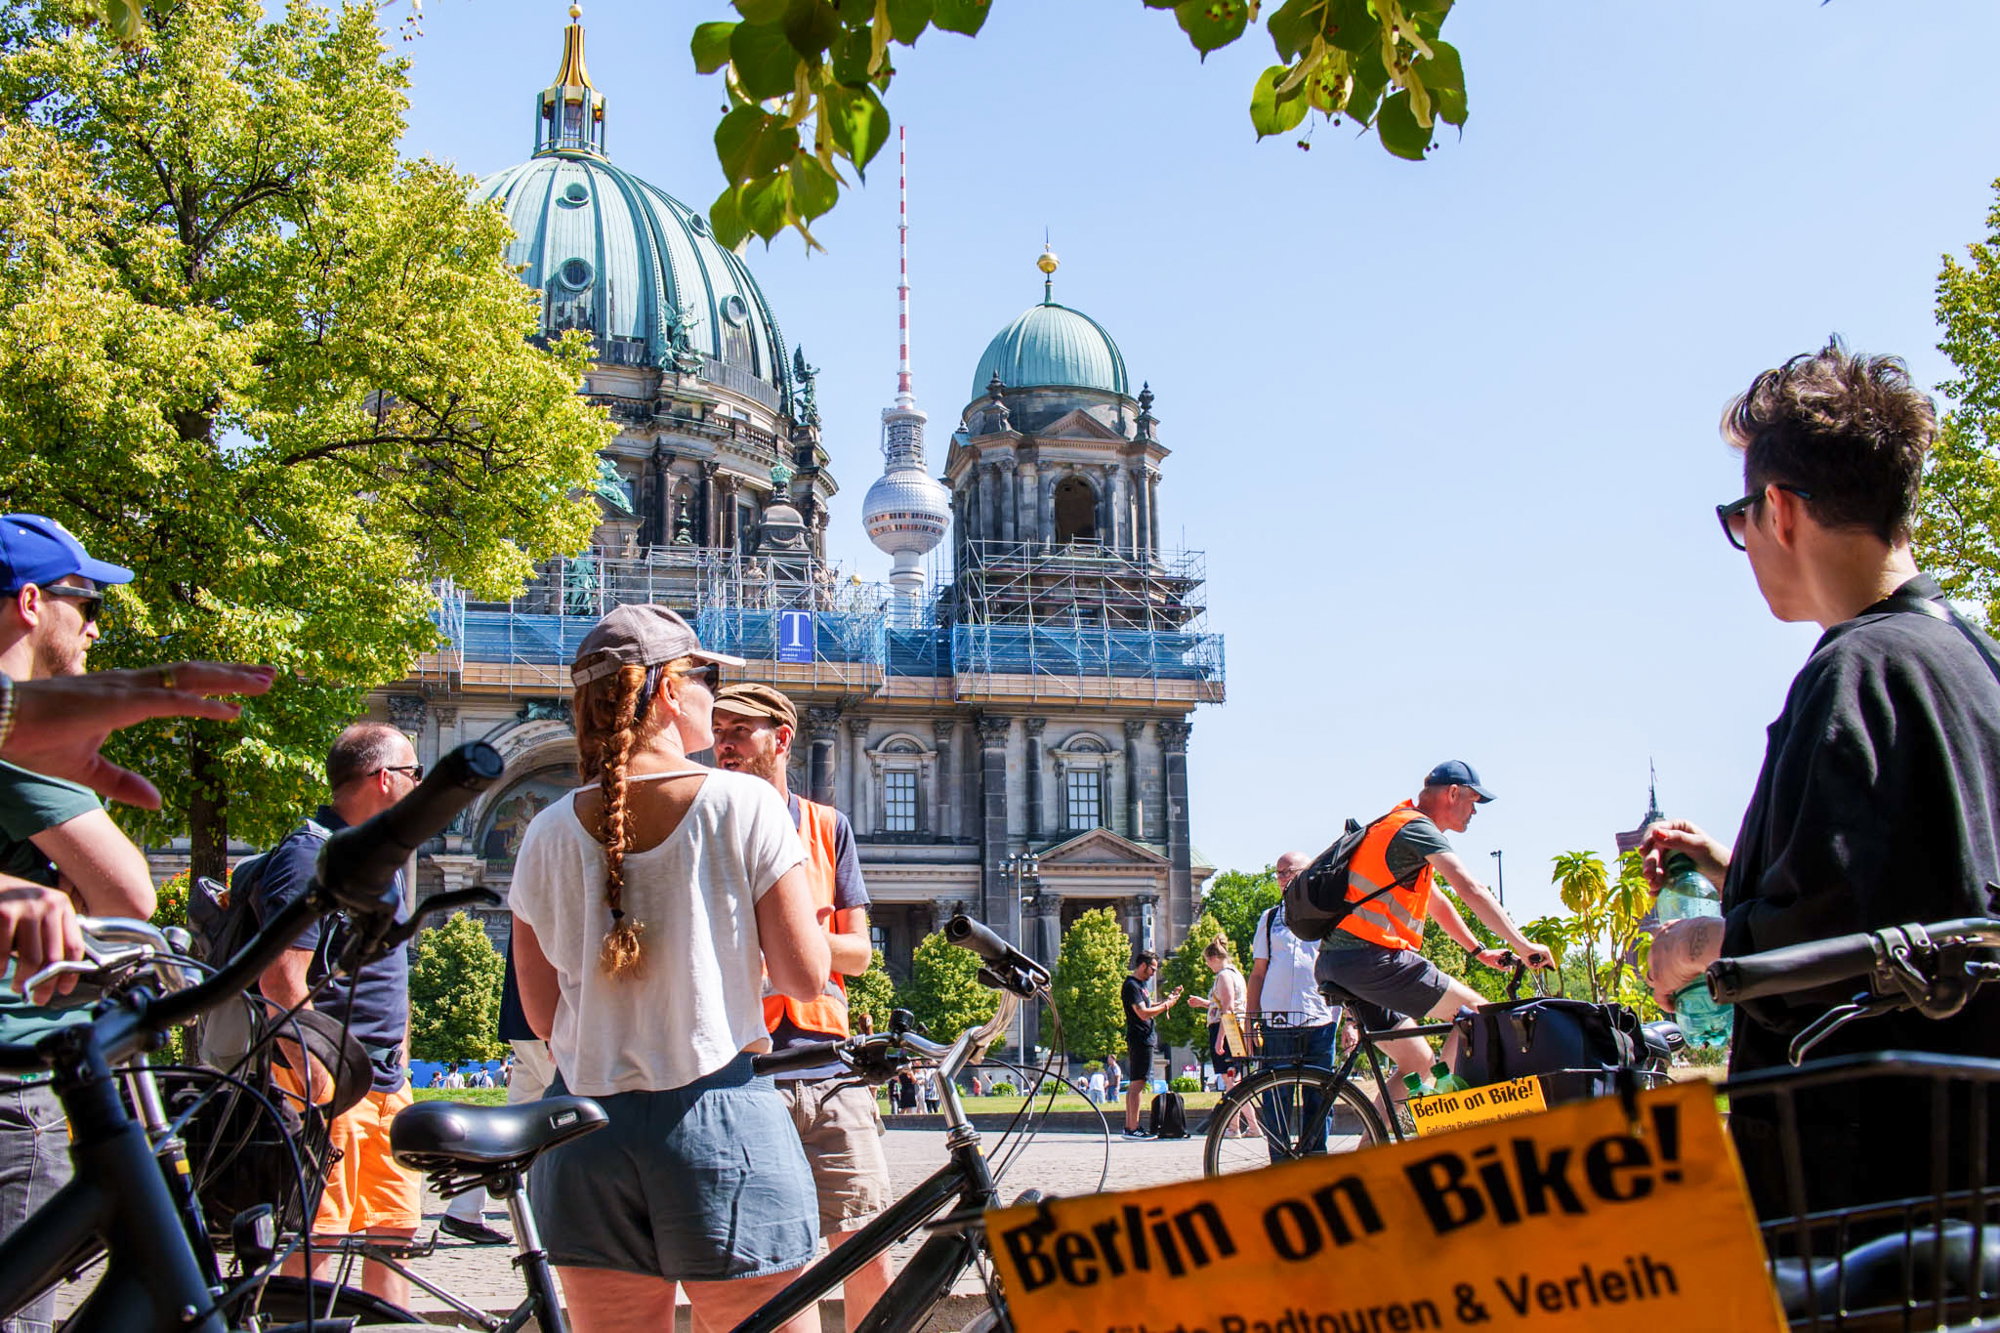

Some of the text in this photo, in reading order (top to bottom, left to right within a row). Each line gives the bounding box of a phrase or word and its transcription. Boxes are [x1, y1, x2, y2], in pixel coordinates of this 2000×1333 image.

[1413, 1080, 1534, 1118] Berlin on Bike!
[1002, 1104, 1684, 1292] Berlin on Bike!
[1454, 1282, 1491, 1325] &
[1496, 1254, 1680, 1318] Verleih
